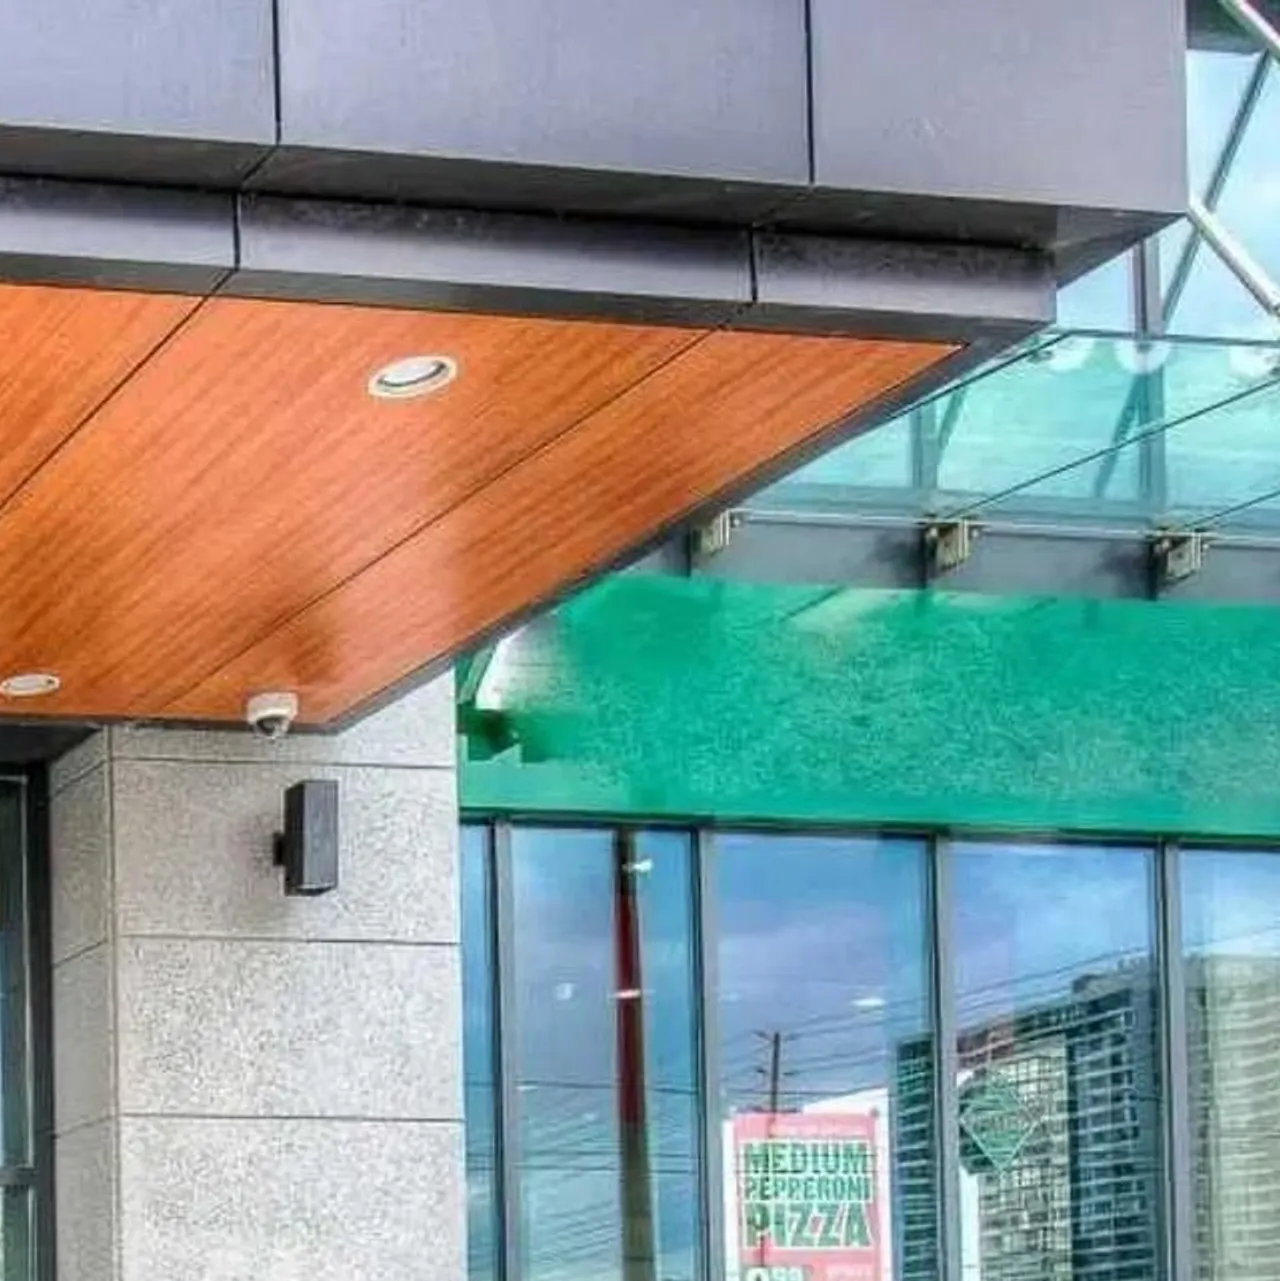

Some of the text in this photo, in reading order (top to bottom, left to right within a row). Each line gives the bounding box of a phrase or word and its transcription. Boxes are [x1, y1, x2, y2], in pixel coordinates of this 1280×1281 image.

[743, 1141, 870, 1174] MEDIUM
[744, 1176, 872, 1201] PEPPERONI
[743, 1202, 873, 1248] PIZZA
